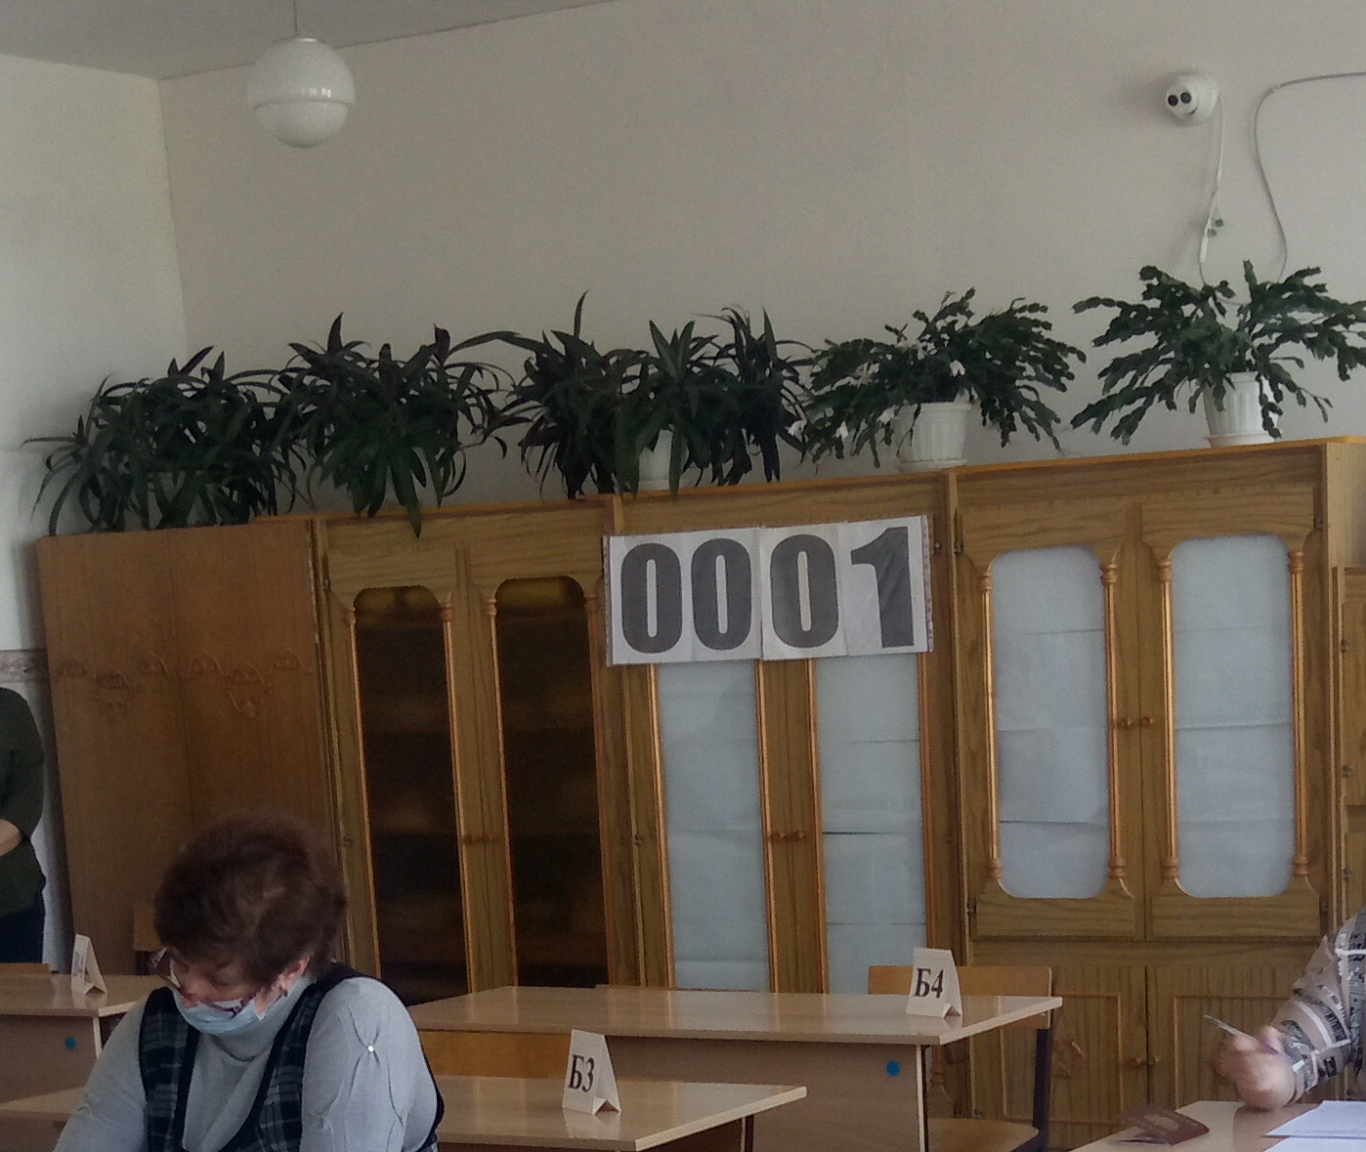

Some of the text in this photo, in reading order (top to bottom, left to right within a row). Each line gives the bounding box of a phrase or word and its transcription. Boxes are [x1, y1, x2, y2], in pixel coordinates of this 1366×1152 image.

[620, 526, 915, 654] 0001
[914, 967, 944, 999] Б4
[568, 1053, 595, 1093] Б3
